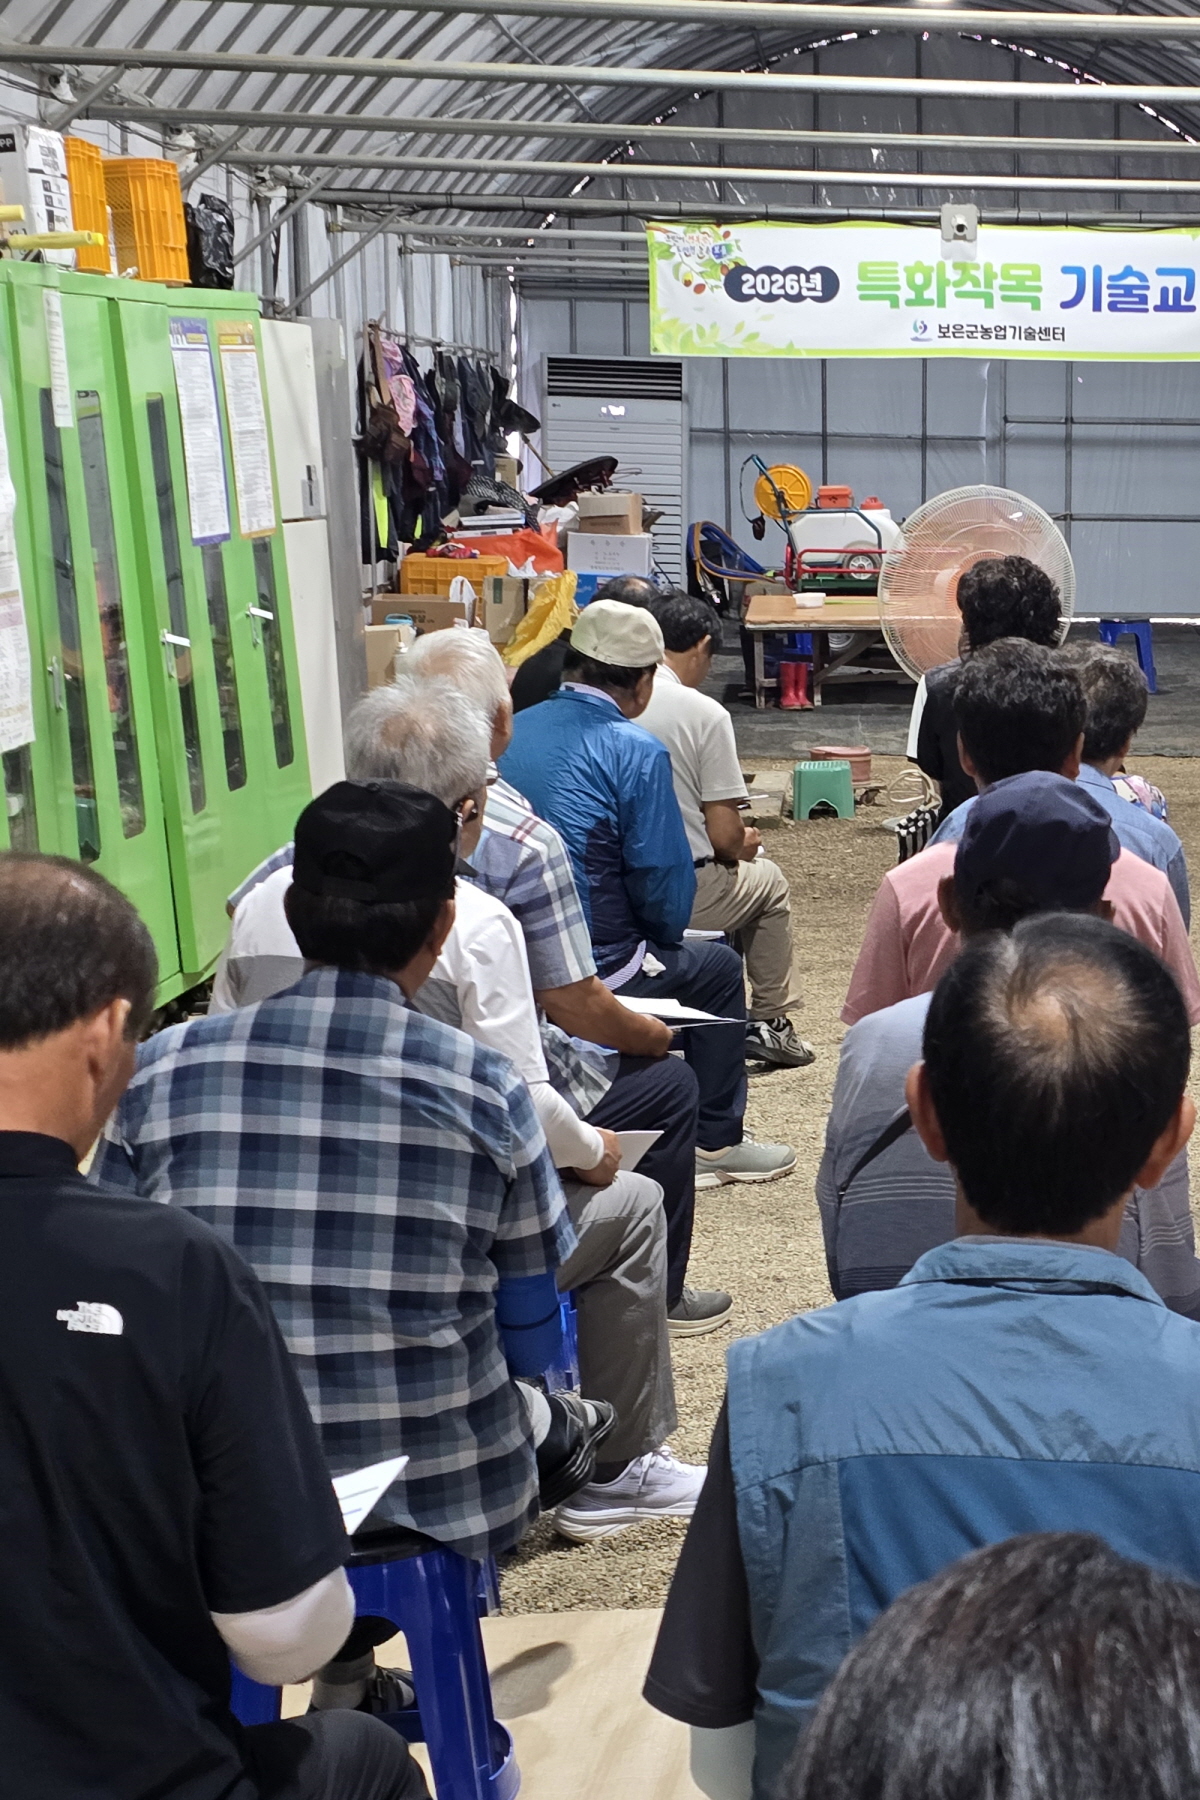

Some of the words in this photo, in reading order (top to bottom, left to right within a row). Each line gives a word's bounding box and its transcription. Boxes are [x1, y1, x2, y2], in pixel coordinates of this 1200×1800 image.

[741, 272, 823, 297] 2026년
[856, 260, 1043, 311] 특화작목
[937, 323, 1066, 342] 보은군농업기술센터
